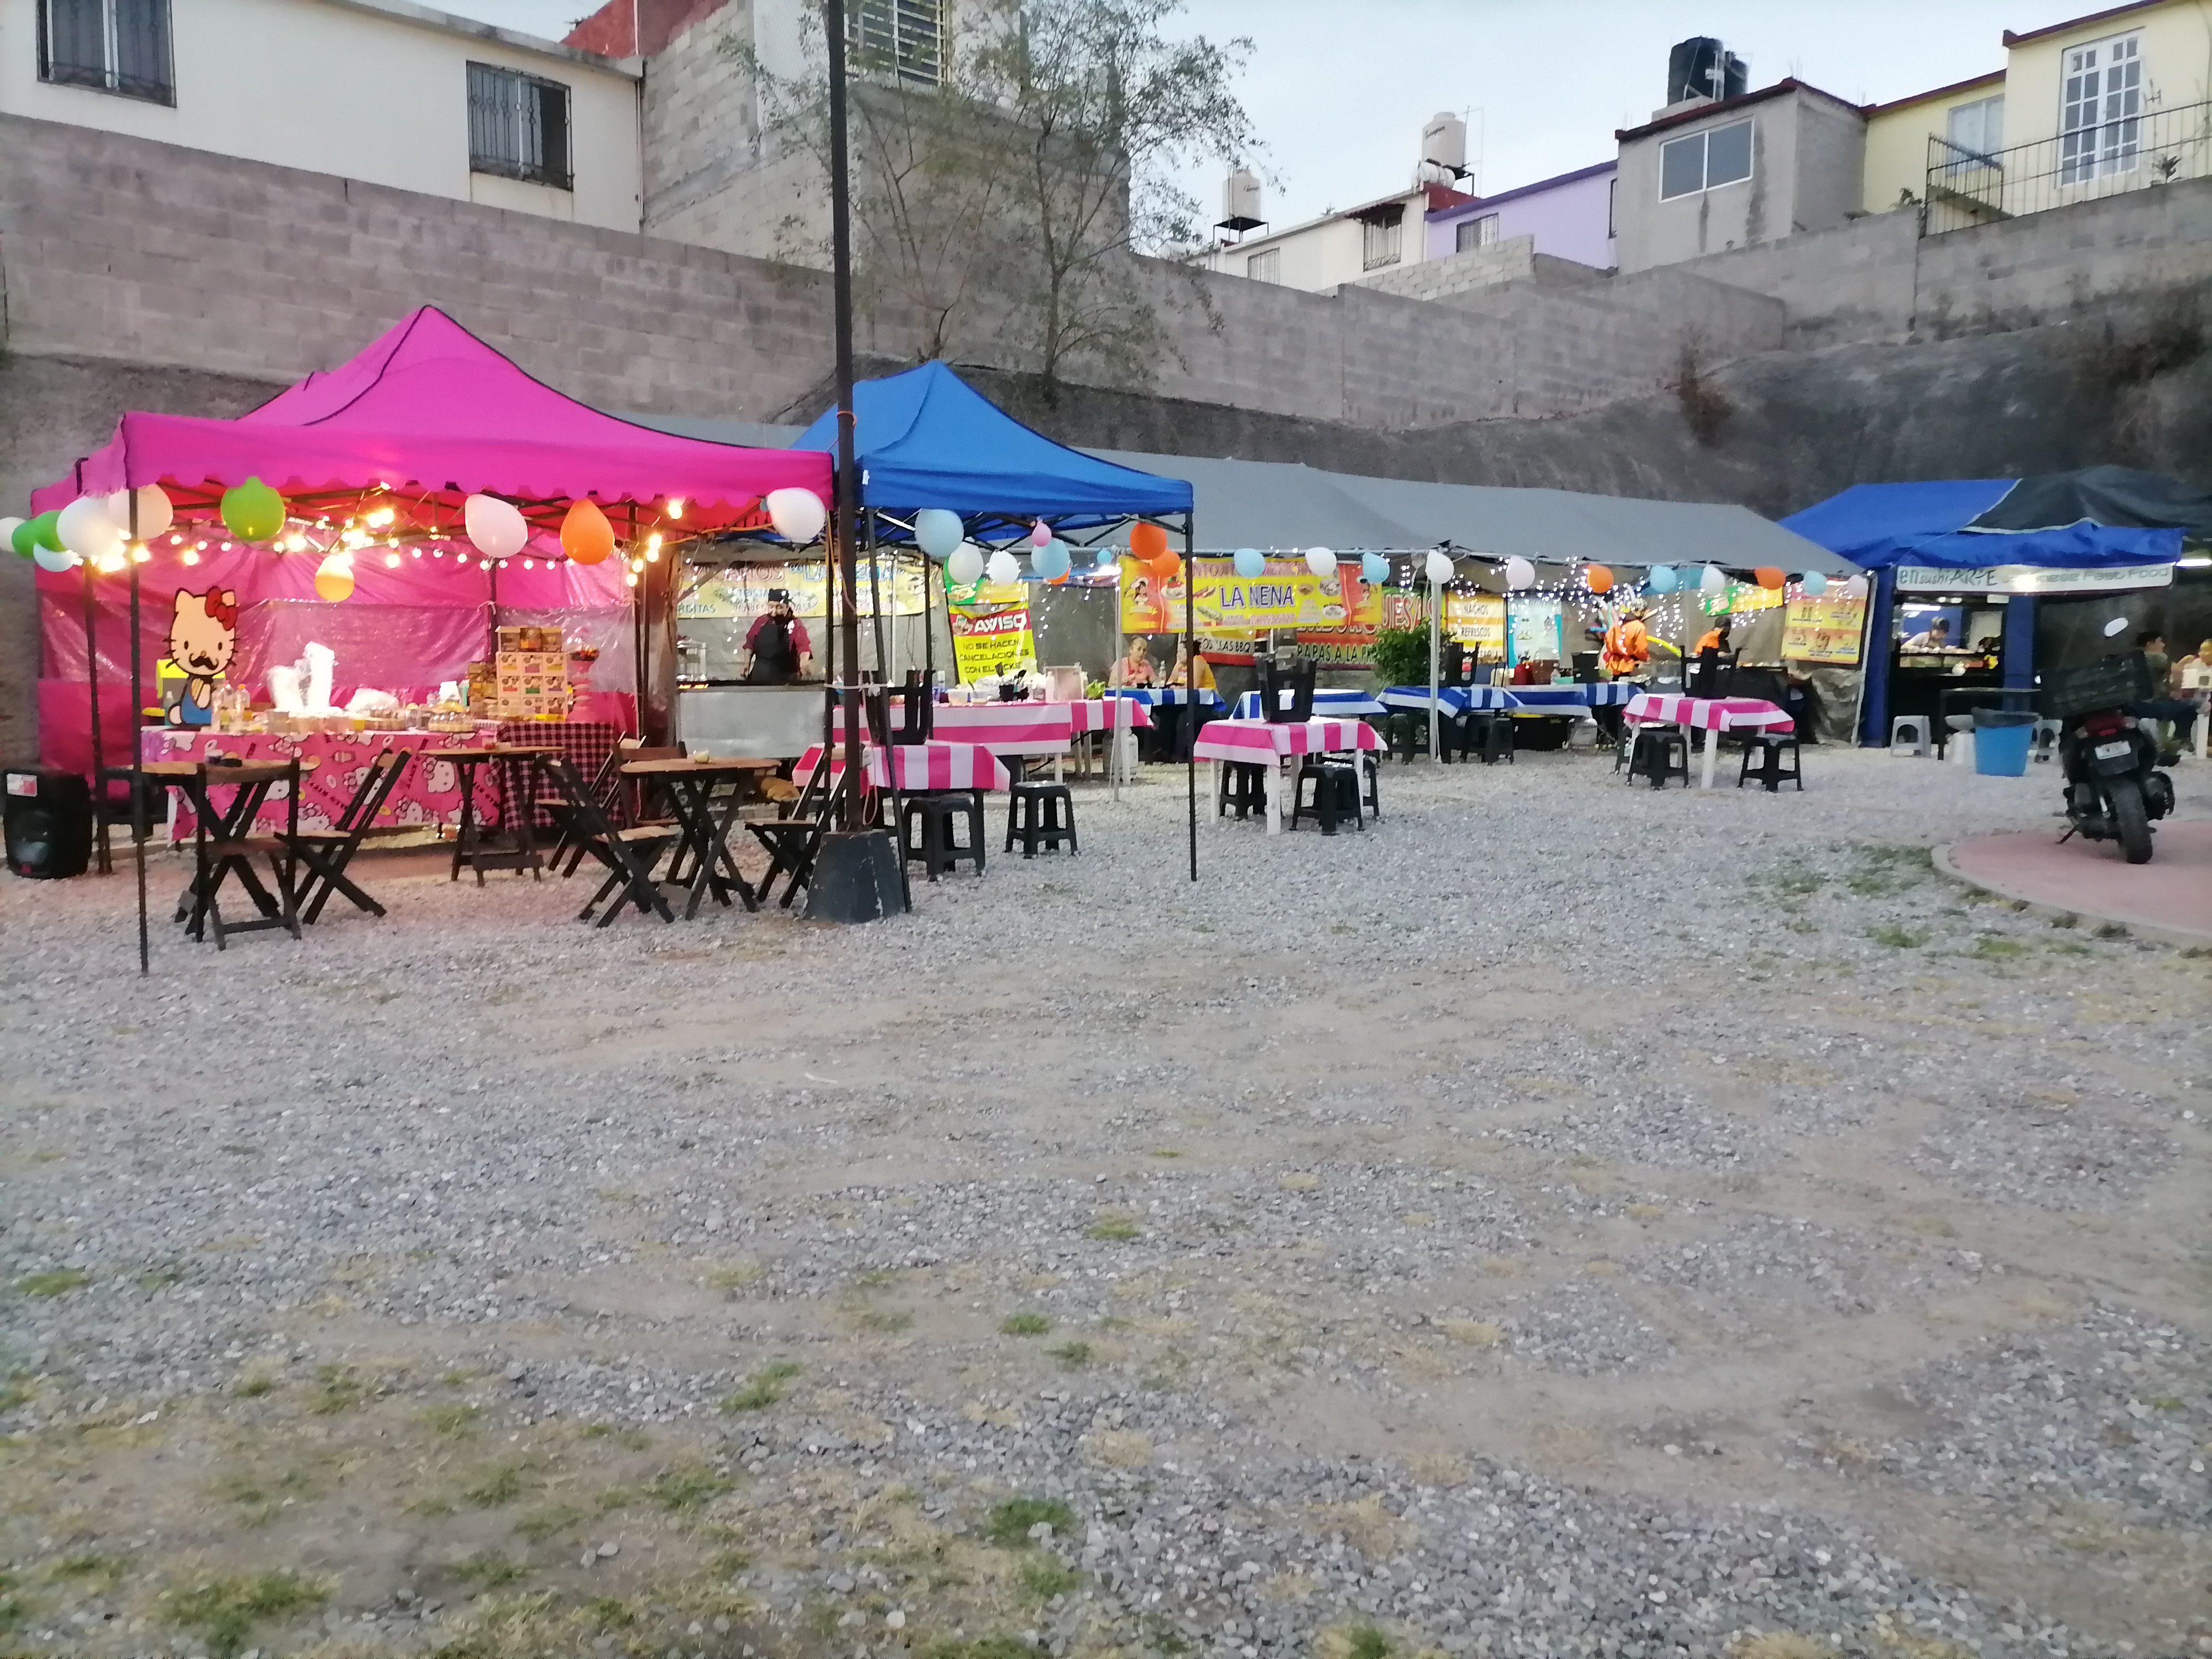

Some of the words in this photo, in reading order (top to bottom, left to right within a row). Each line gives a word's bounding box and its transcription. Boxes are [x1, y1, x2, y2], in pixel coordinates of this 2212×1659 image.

[1220, 585, 1245, 608] LA
[1248, 584, 1295, 607] NENA
[1464, 604, 1489, 615] NACHOS
[974, 613, 1027, 633] AVISO
[1461, 627, 1490, 638] REFRESCOS
[1297, 643, 1331, 661] PAPAS
[1334, 644, 1342, 662] A
[1346, 644, 1358, 662] LA
